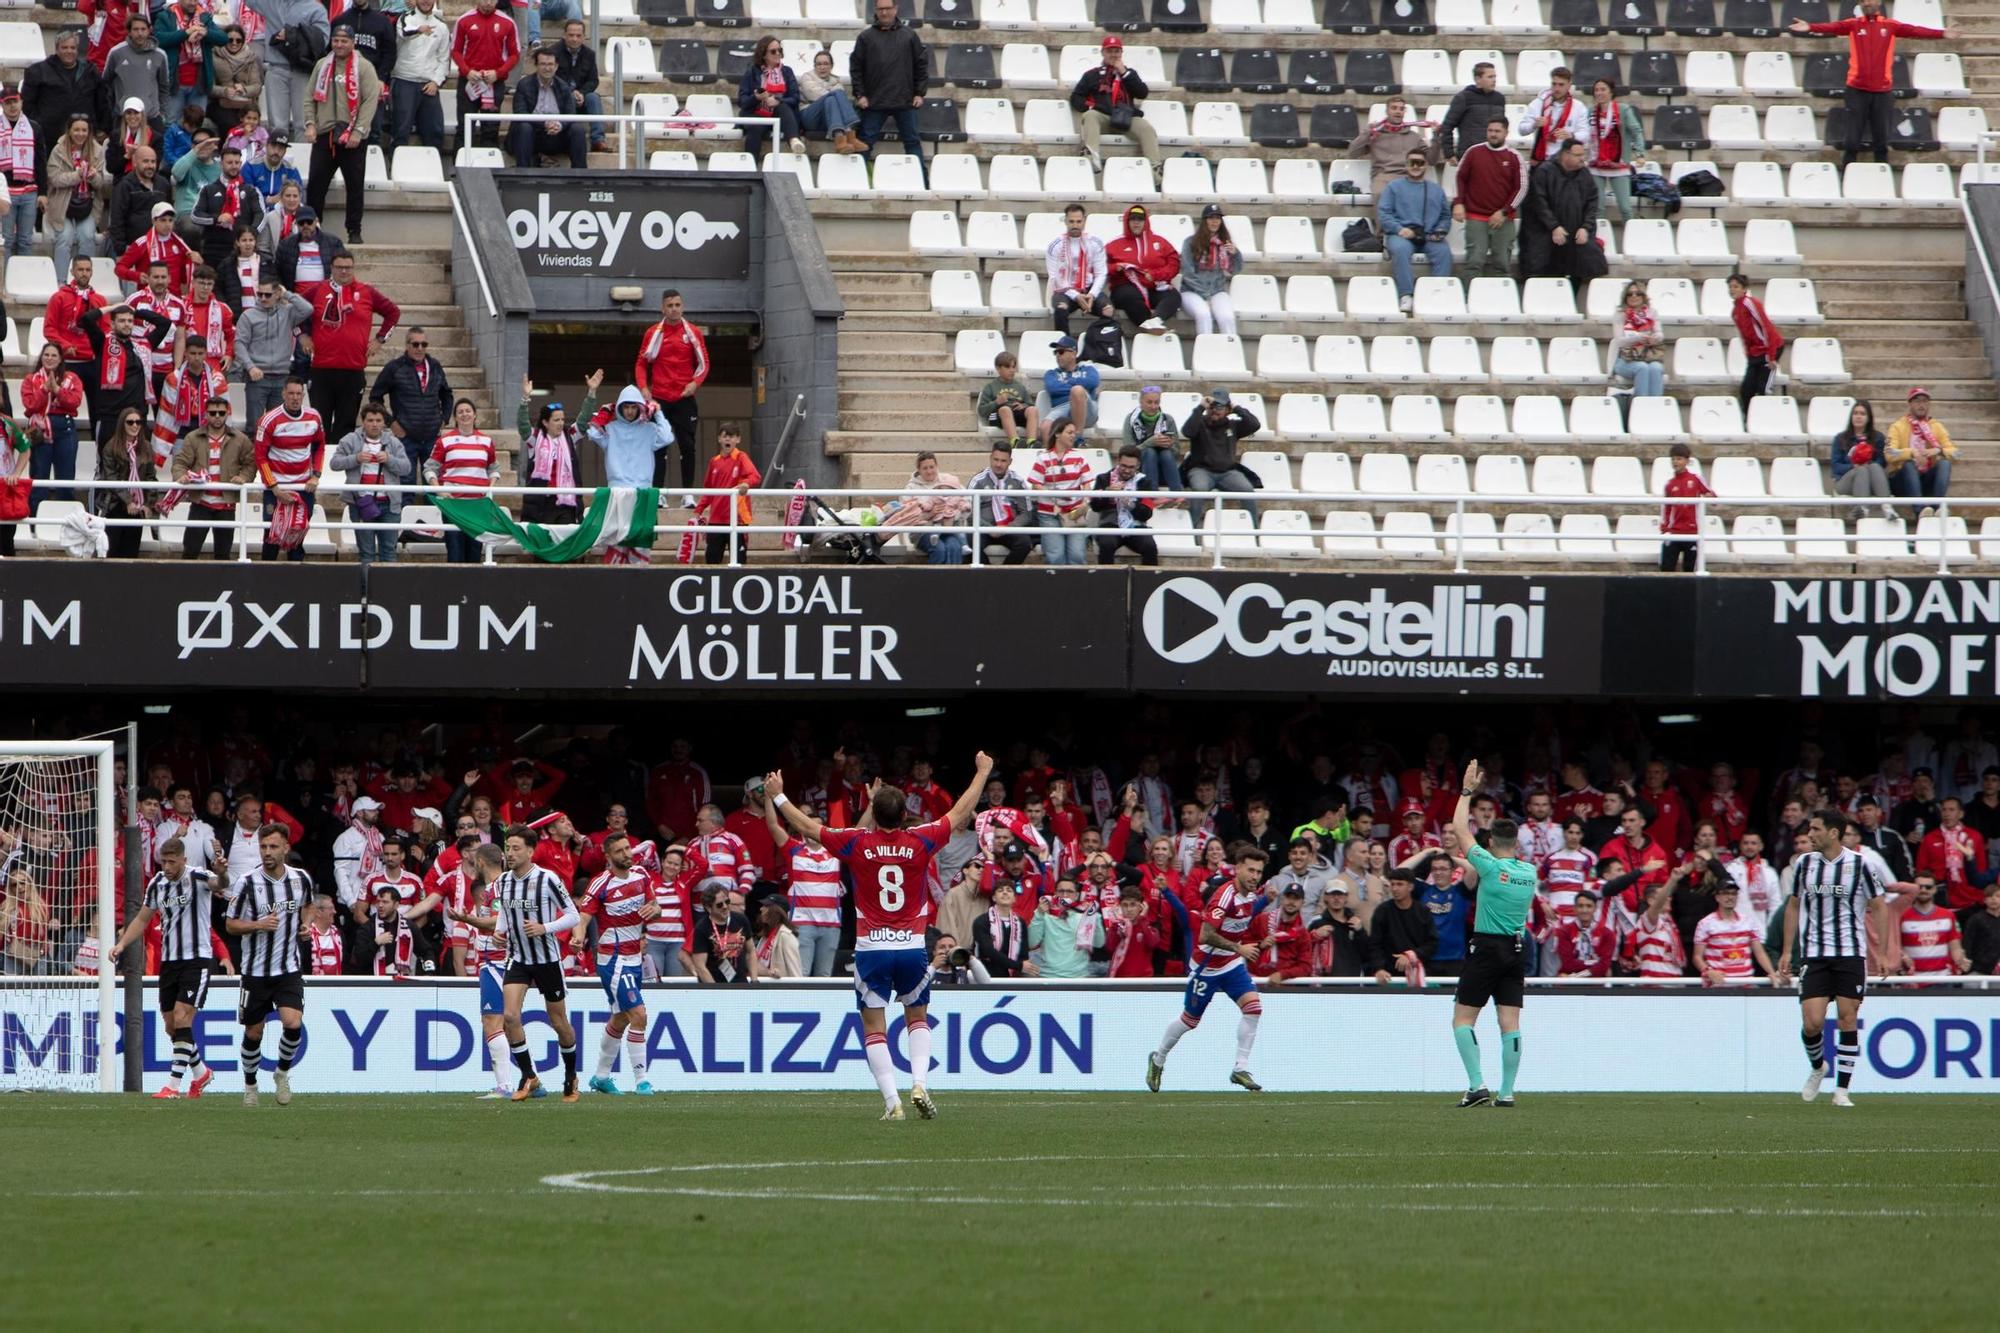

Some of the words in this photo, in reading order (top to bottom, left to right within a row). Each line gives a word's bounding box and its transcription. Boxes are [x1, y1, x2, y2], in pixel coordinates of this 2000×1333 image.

[506, 193, 632, 266] okey
[538, 253, 592, 267] Viviendas
[668, 574, 862, 615] GLOBAL
[0, 599, 80, 645] M
[1223, 582, 1546, 659] Castellini
[1504, 662, 1544, 679] S.L.
[1796, 632, 2000, 697] MOF
[878, 864, 904, 912] 8
[870, 927, 913, 942] wiber
[621, 973, 636, 989] 17
[1193, 978, 1208, 996] 12
[331, 1009, 389, 1072] Y
[415, 995, 1093, 1075] DGIALIZACIÓN
[1823, 1017, 2000, 1080] FOR
